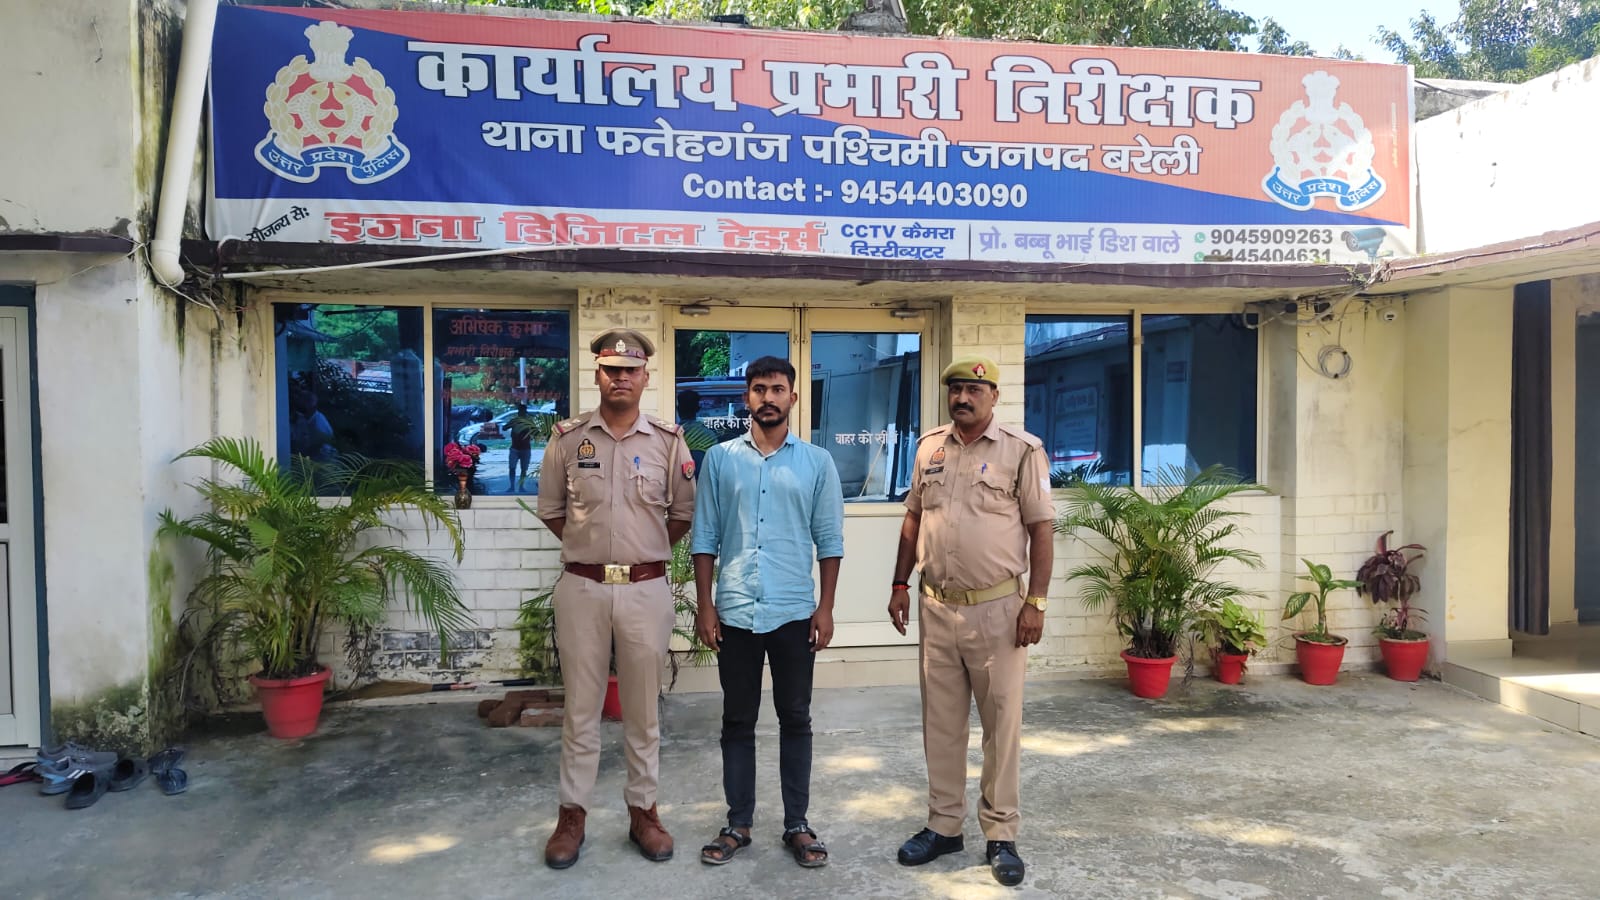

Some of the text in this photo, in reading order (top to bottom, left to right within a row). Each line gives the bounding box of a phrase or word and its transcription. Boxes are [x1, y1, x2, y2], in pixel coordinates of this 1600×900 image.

[407, 34, 1262, 129] कार्यालय प्रभारी निरीक्षक
[481, 116, 1202, 175] थाना फतेहगंज पश्चिमी जनपद बरेली
[268, 147, 400, 178] उत्तर प्रदेश पुलिस
[682, 173, 806, 202] Contact
[840, 180, 1027, 208] 9454403090
[1272, 179, 1378, 206] उत्तर प्रदेश पुलिस
[499, 211, 706, 247] डिजिटल
[841, 222, 956, 240] CCTV कैमरा
[1056, 227, 1094, 254] भाई
[1099, 228, 1138, 253] डिश
[1142, 230, 1182, 254] वाले
[1211, 229, 1333, 244] 9045909263
[449, 315, 504, 336] अभिषेक
[858, 429, 873, 444] को
